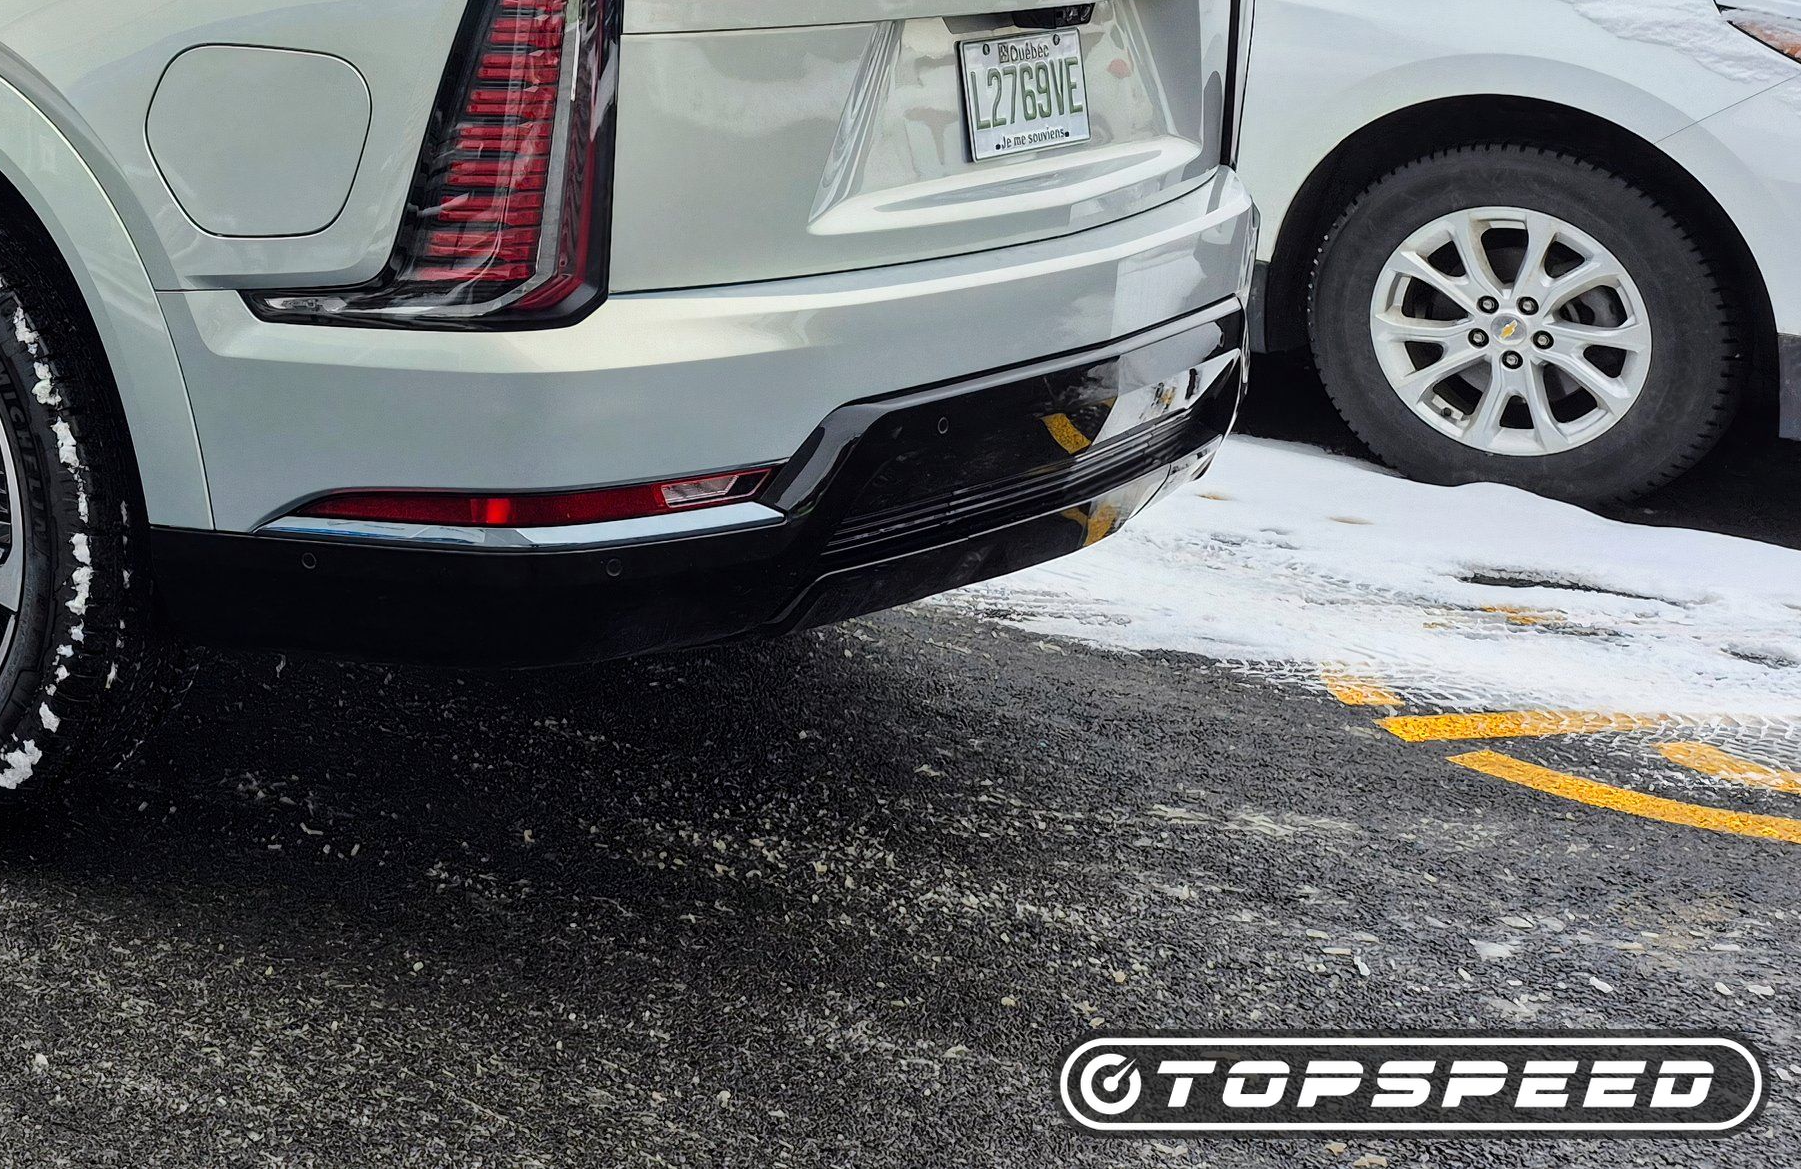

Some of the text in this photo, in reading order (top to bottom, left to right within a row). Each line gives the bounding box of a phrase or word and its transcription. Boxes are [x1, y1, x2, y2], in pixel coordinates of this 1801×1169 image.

[1009, 42, 1050, 62] Québec
[970, 56, 1084, 130] L2769VE
[1001, 136, 1012, 150] Je
[1027, 127, 1065, 144] souviens
